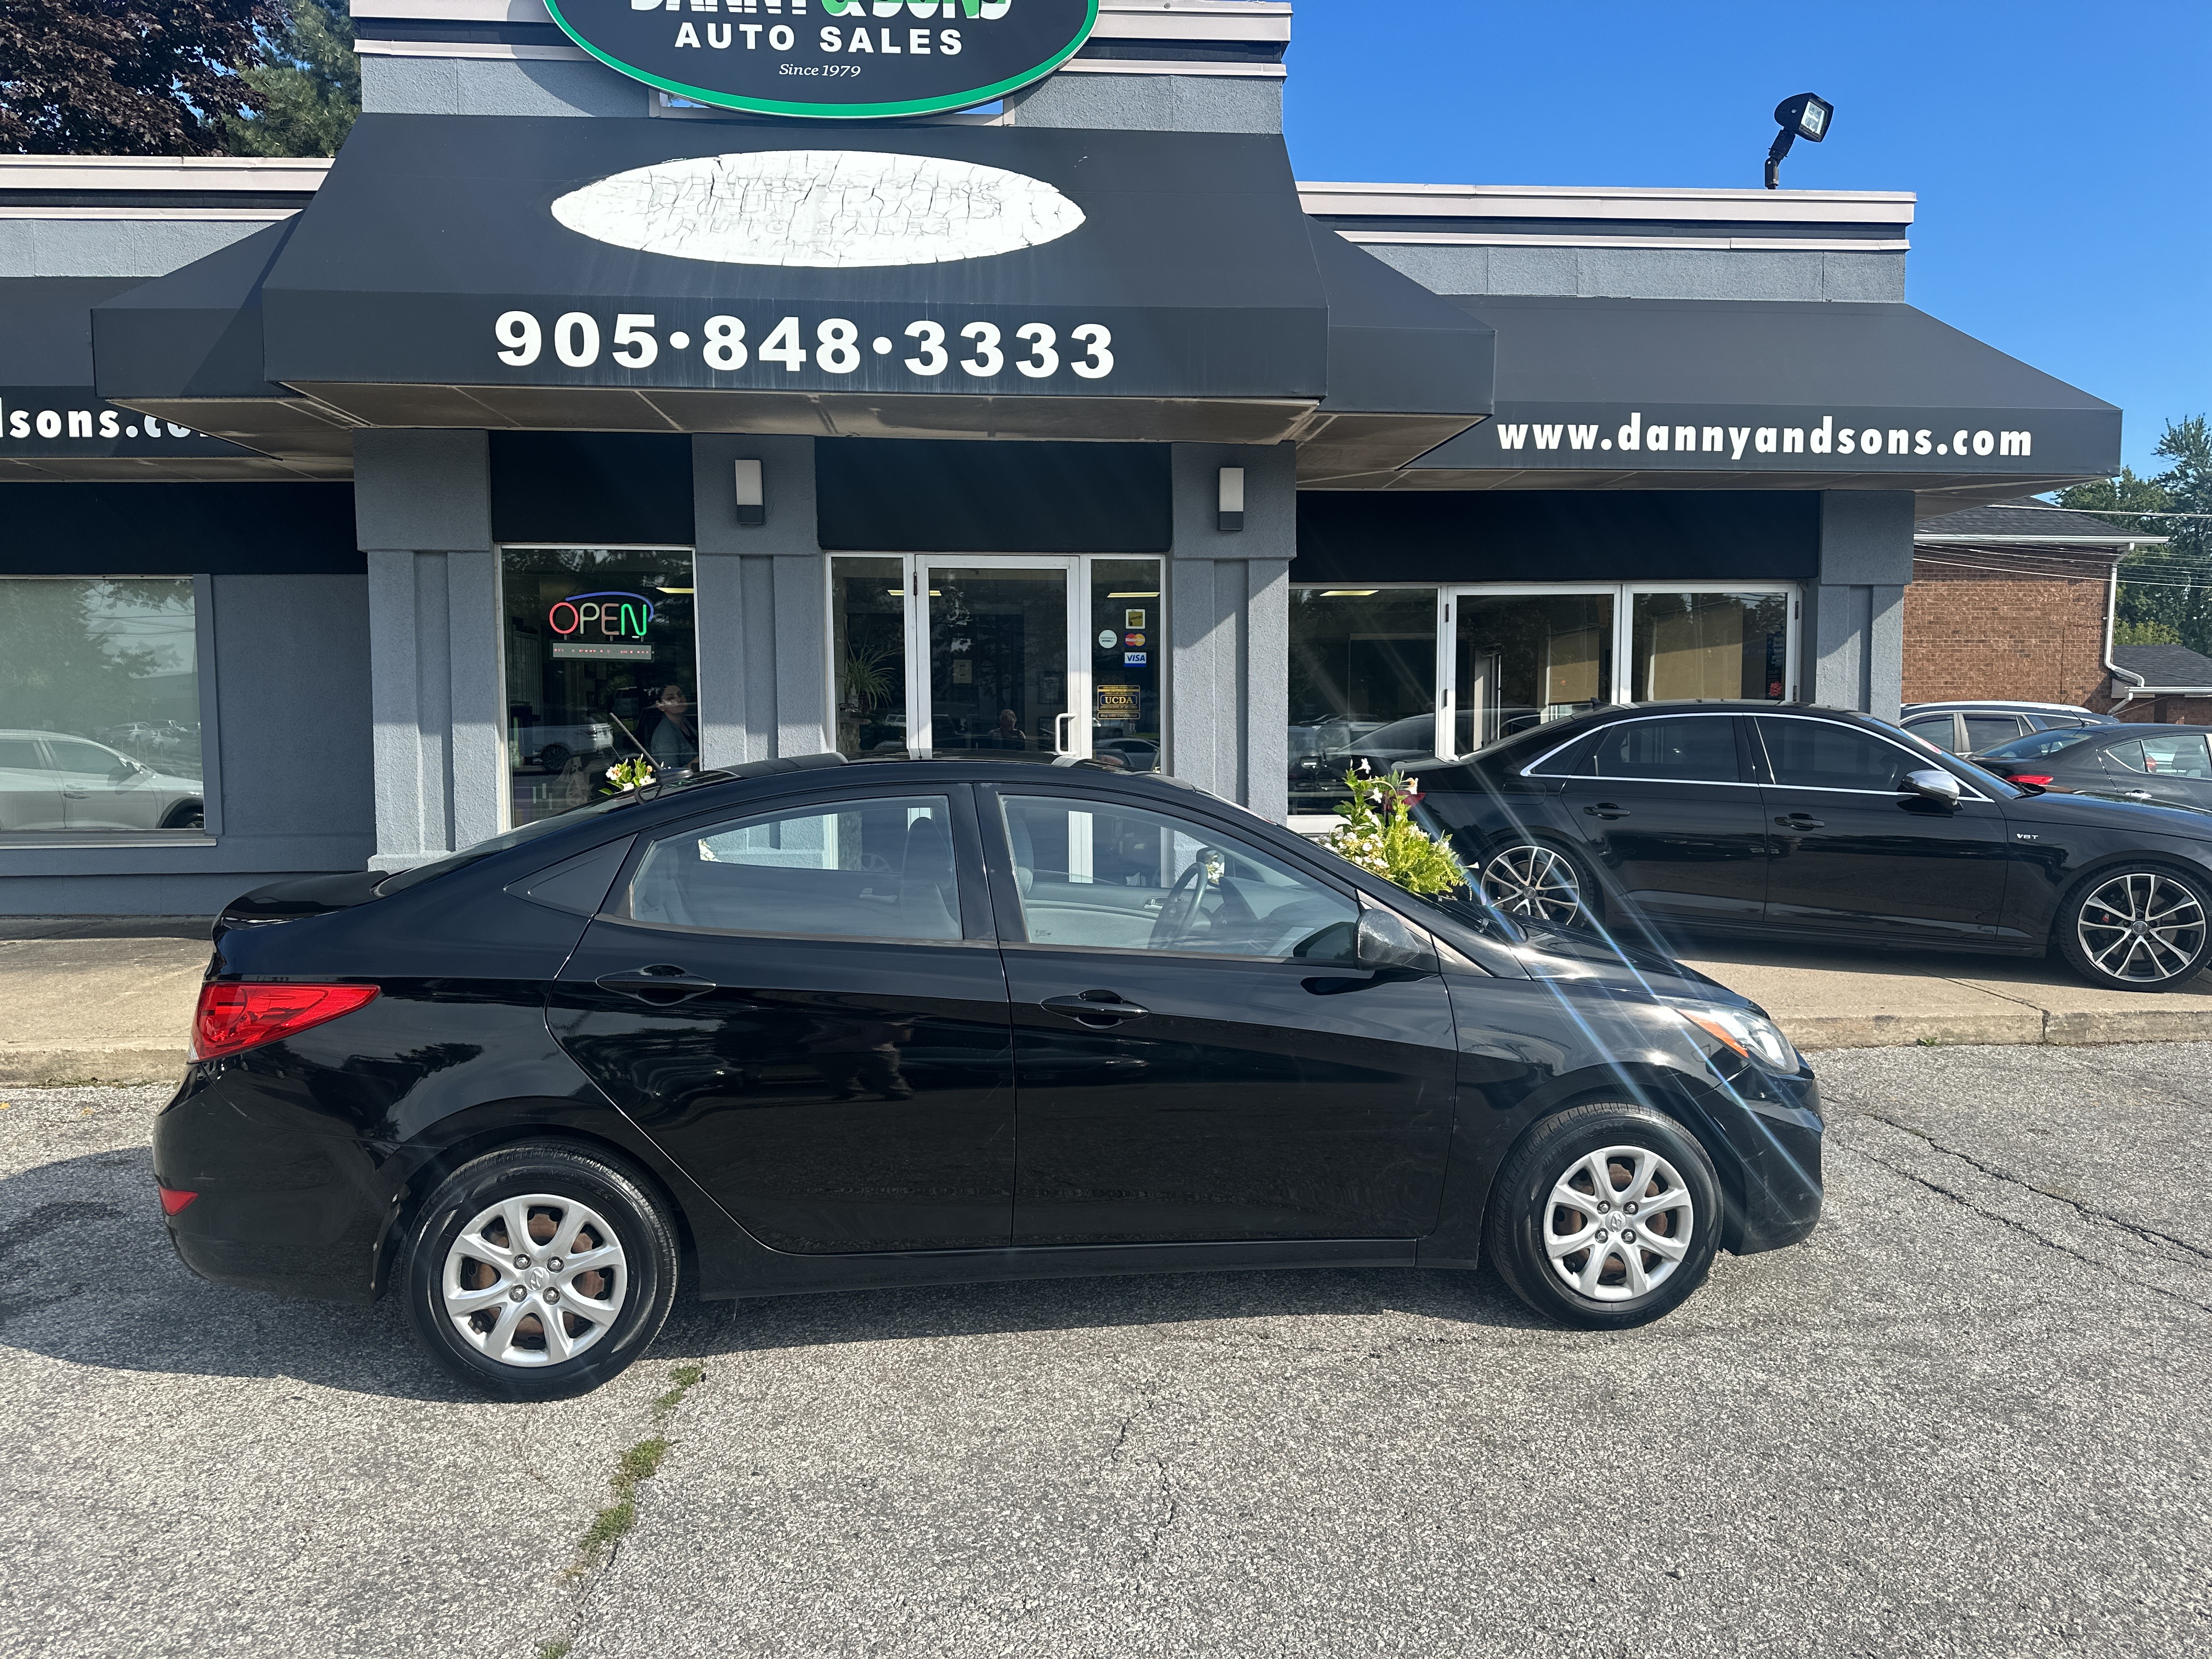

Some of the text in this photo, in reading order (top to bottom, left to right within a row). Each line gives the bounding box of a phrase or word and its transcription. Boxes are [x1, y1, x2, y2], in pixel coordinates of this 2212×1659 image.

[674, 22, 962, 55] AUTO SALES
[779, 64, 861, 77] Since 1979
[1497, 412, 2032, 460] www.dannyandsons.com
[549, 602, 647, 636] OPEN
